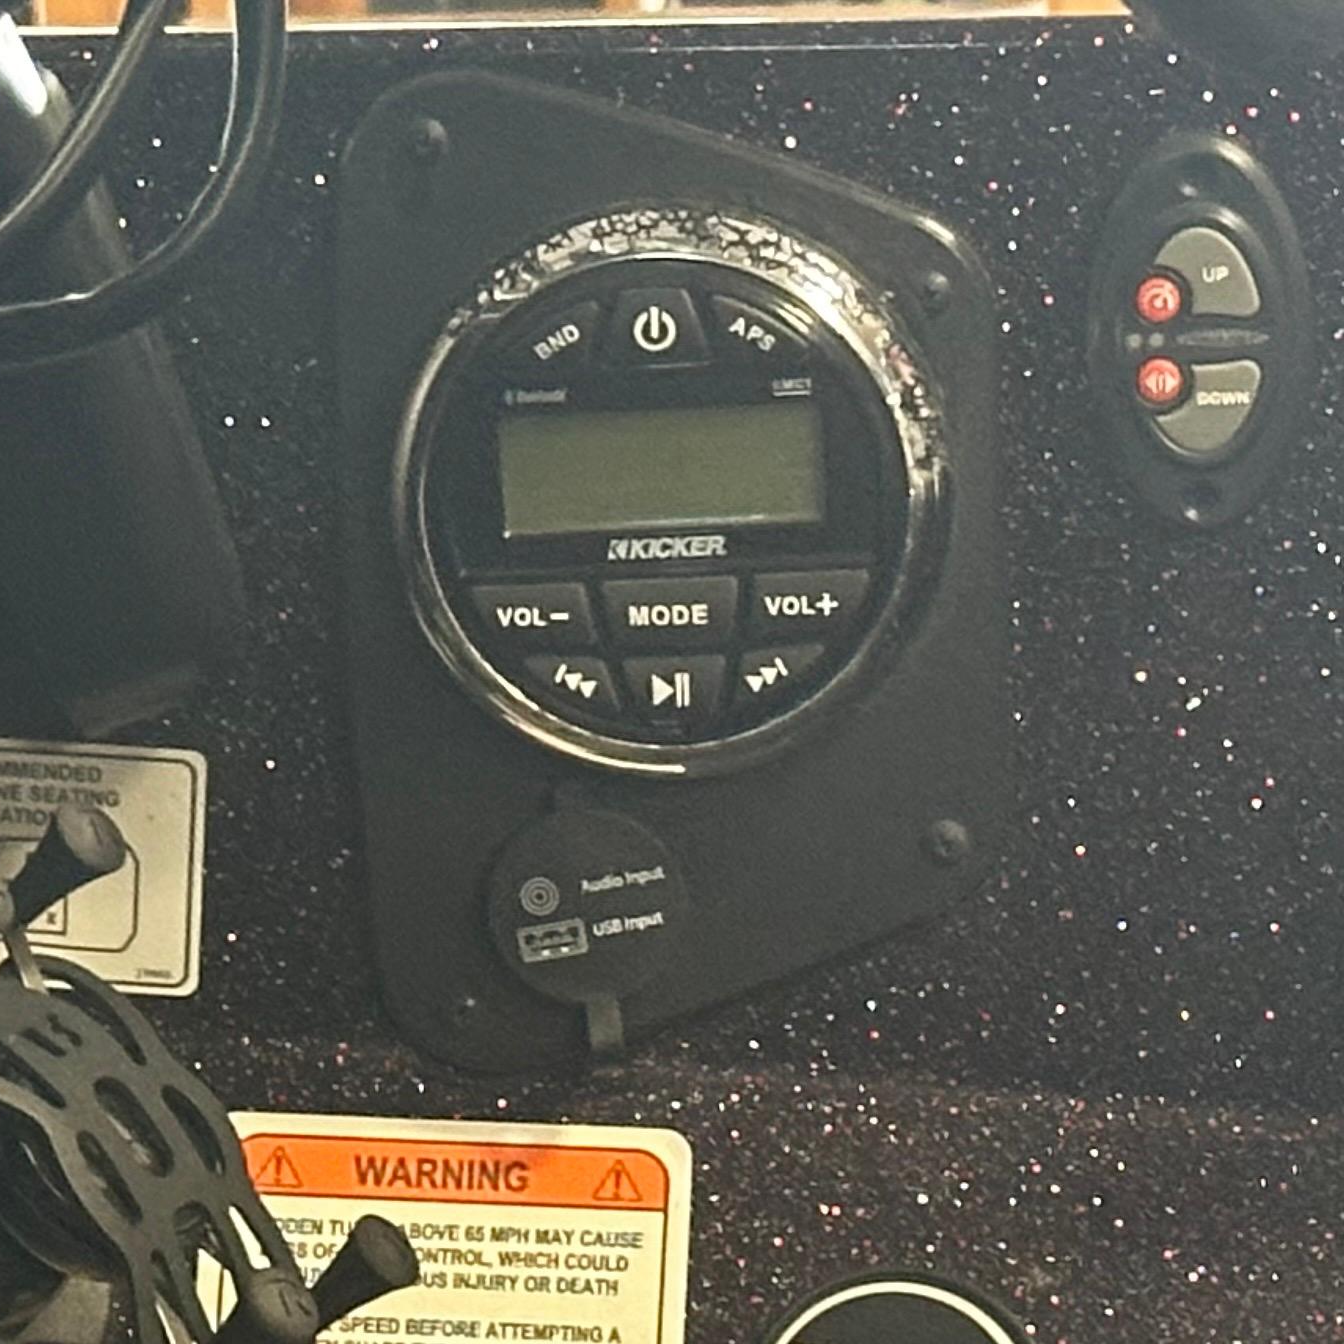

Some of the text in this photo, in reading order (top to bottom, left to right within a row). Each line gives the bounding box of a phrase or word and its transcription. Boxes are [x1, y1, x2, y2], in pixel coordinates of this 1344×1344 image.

[1202, 265, 1229, 283] UP
[534, 323, 581, 361] BND
[728, 315, 777, 353] APS
[1197, 391, 1250, 405] DOWN
[630, 534, 727, 560] KICKER
[629, 603, 709, 627] MODE
[28, 785, 120, 808] SEATING
[625, 866, 665, 886] Input
[593, 911, 664, 937] USB Input
[353, 1153, 529, 1193] WARNING
[408, 1222, 459, 1244] BOVE
[464, 1225, 484, 1242] 65
[489, 1226, 529, 1243] MPH
[534, 1228, 574, 1245] MAY
[579, 1229, 643, 1249] CAUSE
[413, 1246, 492, 1269] ONTROL,
[497, 1250, 559, 1269] WHICH
[563, 1252, 629, 1272] COULD
[452, 1272, 518, 1291] INJURY
[523, 1275, 550, 1293] OR
[555, 1276, 618, 1296] DEATH
[339, 1317, 621, 1344] SPEED BEFORE ATTEMPTING A
